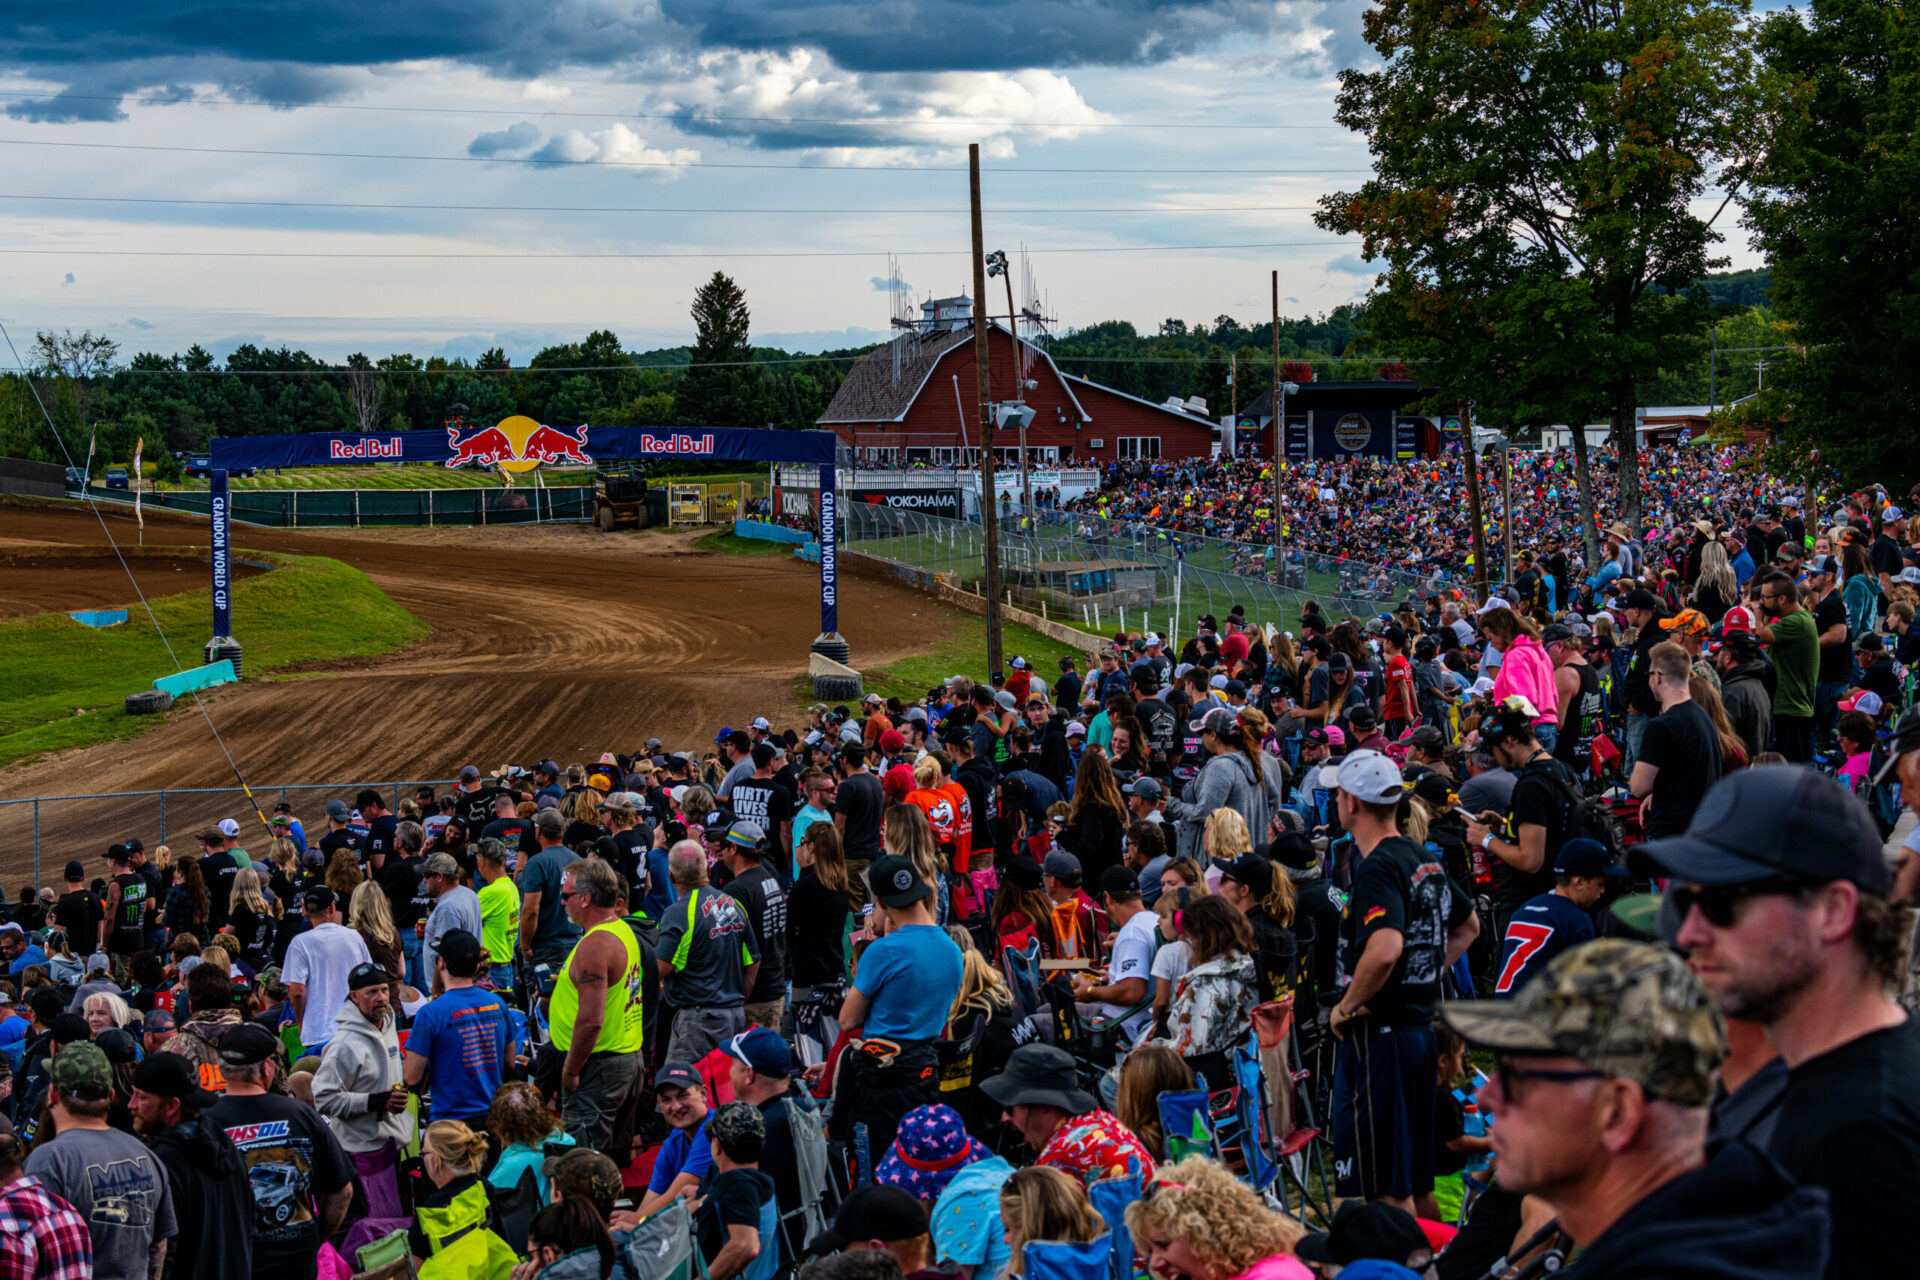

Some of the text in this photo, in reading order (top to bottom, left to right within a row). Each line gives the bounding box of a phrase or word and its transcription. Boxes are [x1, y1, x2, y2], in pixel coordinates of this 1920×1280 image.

[330, 437, 403, 458] Red Bull
[641, 434, 714, 453] Red Bull
[886, 493, 957, 508] YOKOHAMA
[212, 497, 227, 610] CRANDON WORLD CUP
[822, 491, 835, 606] CRANDON WORLD CUP
[733, 785, 774, 803] DIRTY
[733, 800, 768, 816] LIVES
[1495, 921, 1555, 993] 7
